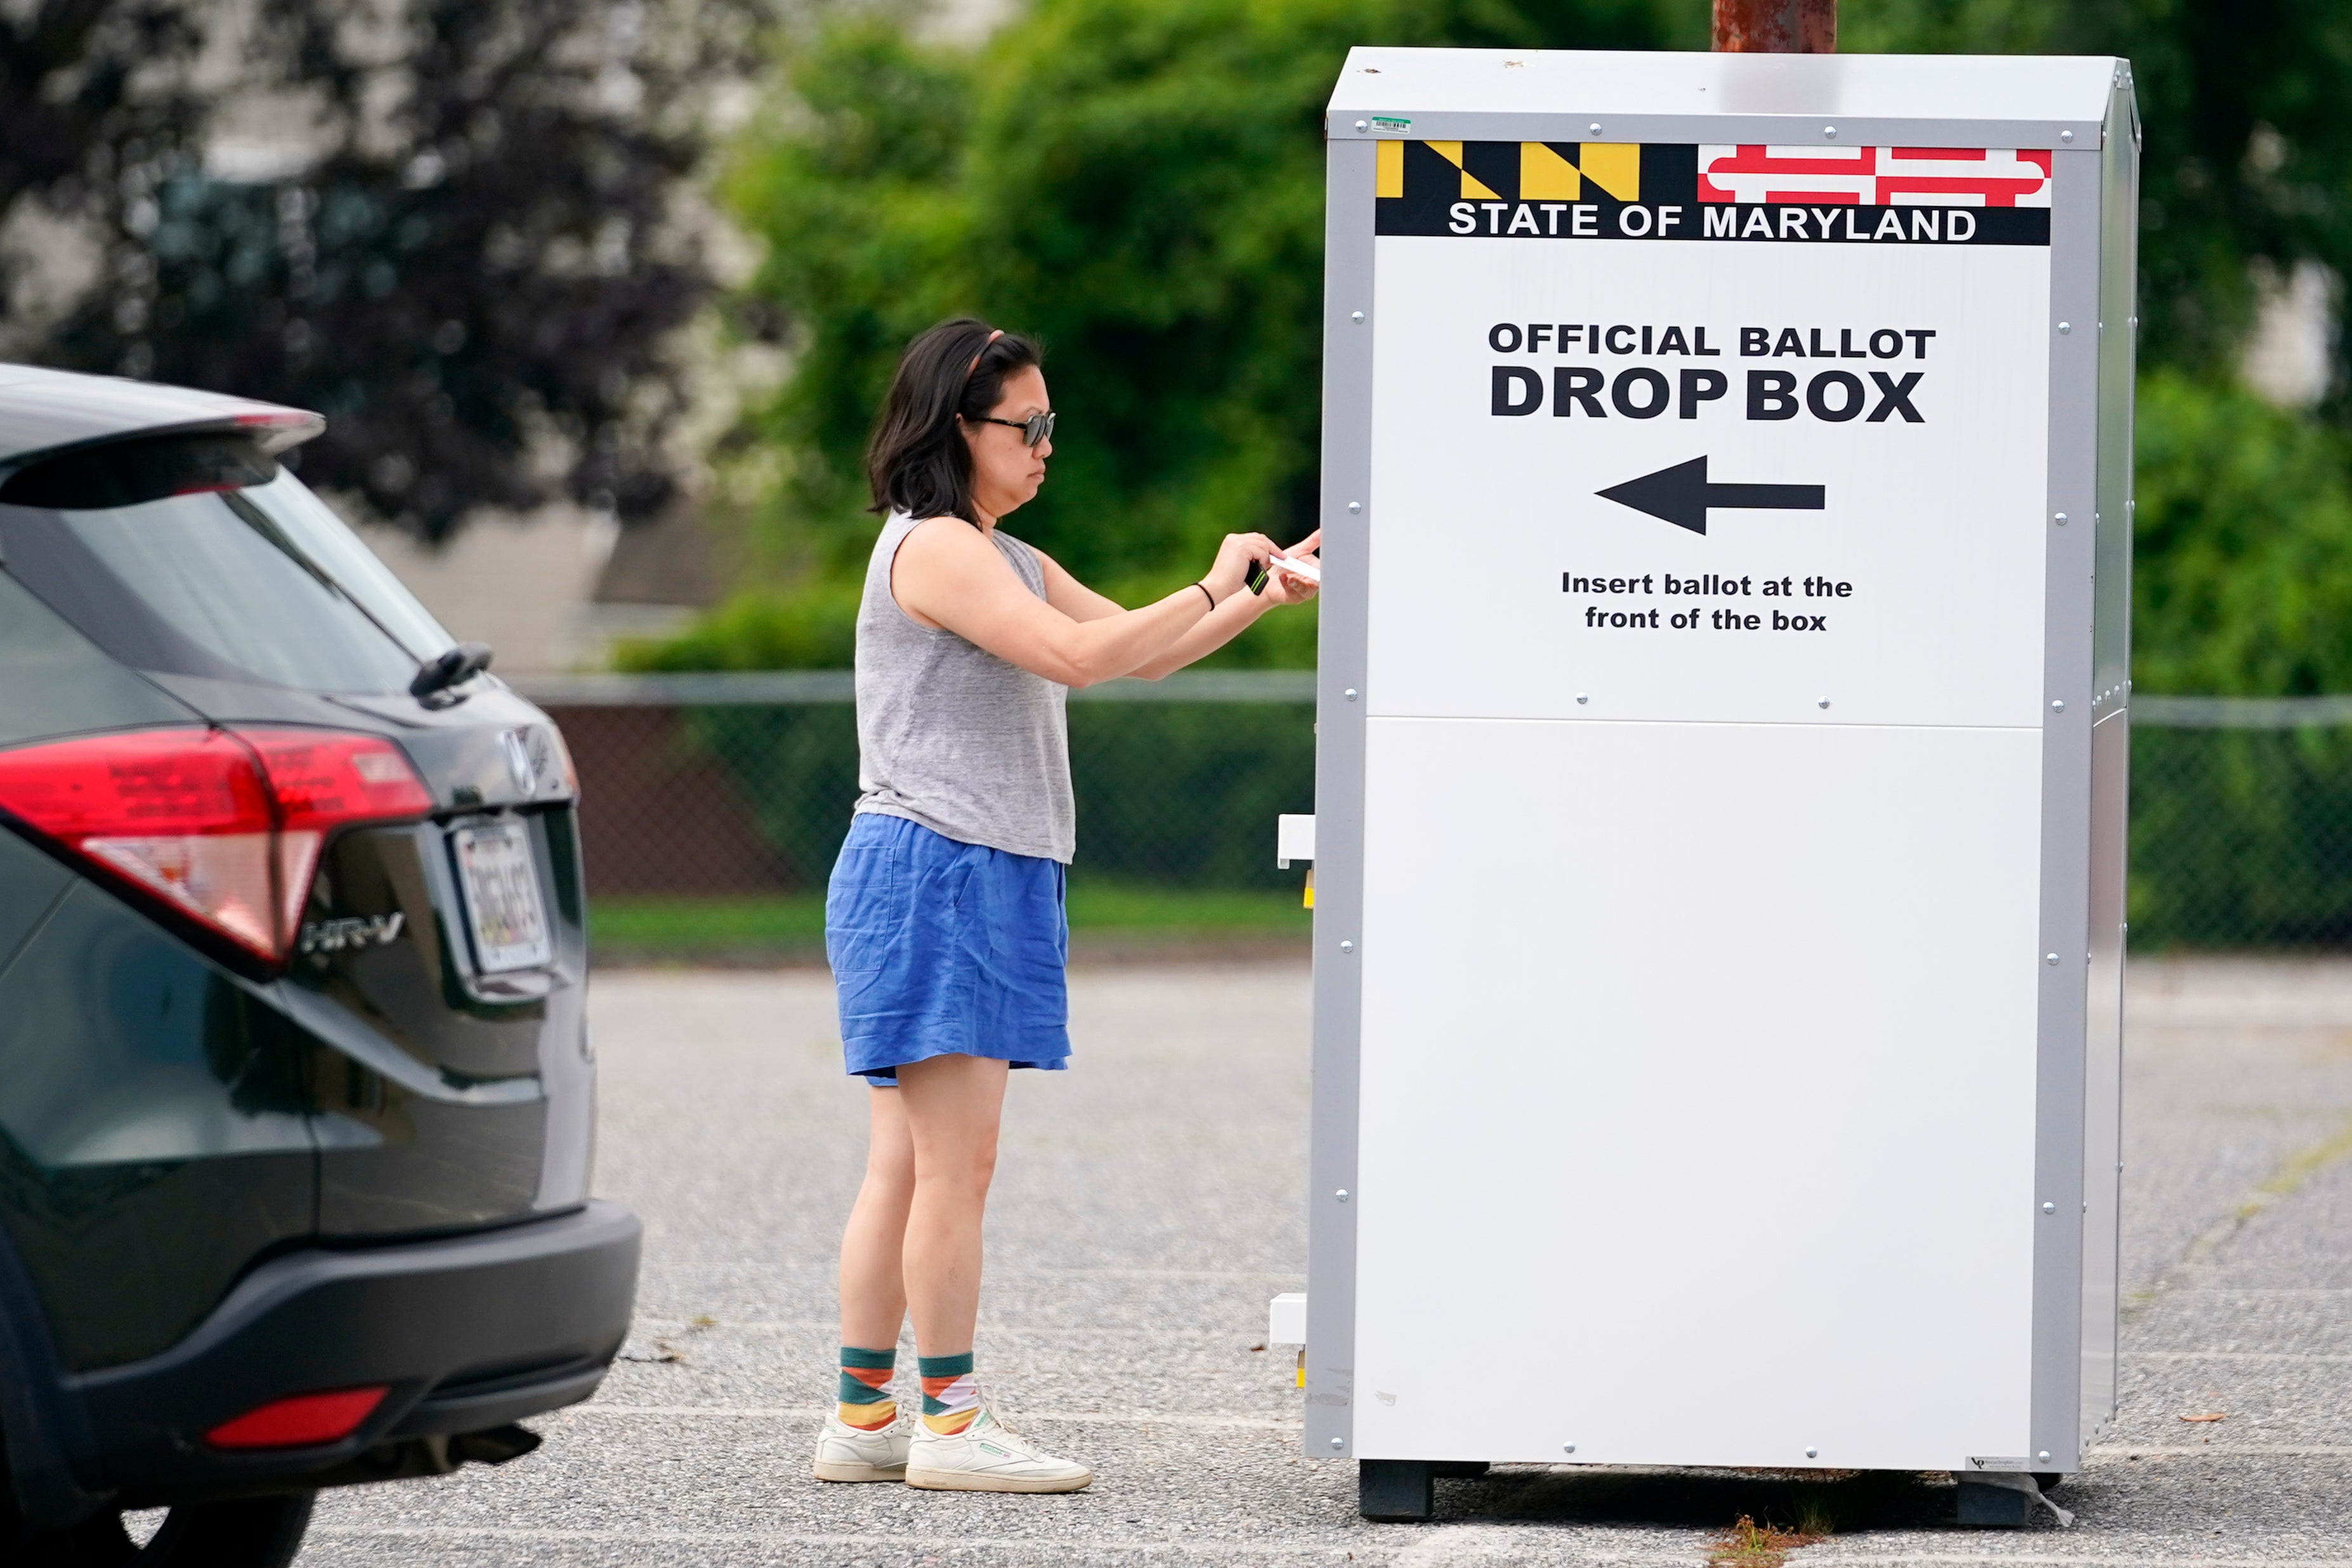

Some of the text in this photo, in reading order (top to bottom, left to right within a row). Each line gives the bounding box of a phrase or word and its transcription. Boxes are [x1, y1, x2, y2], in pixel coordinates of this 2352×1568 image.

[1449, 202, 1976, 241] STATE OF MARYLAND
[1489, 323, 1937, 359] OFFICIAL BALLOT
[1491, 365, 1926, 423] DROP BOX
[1562, 572, 1853, 598] Insert ballot at the
[1585, 606, 1827, 631] front of the box
